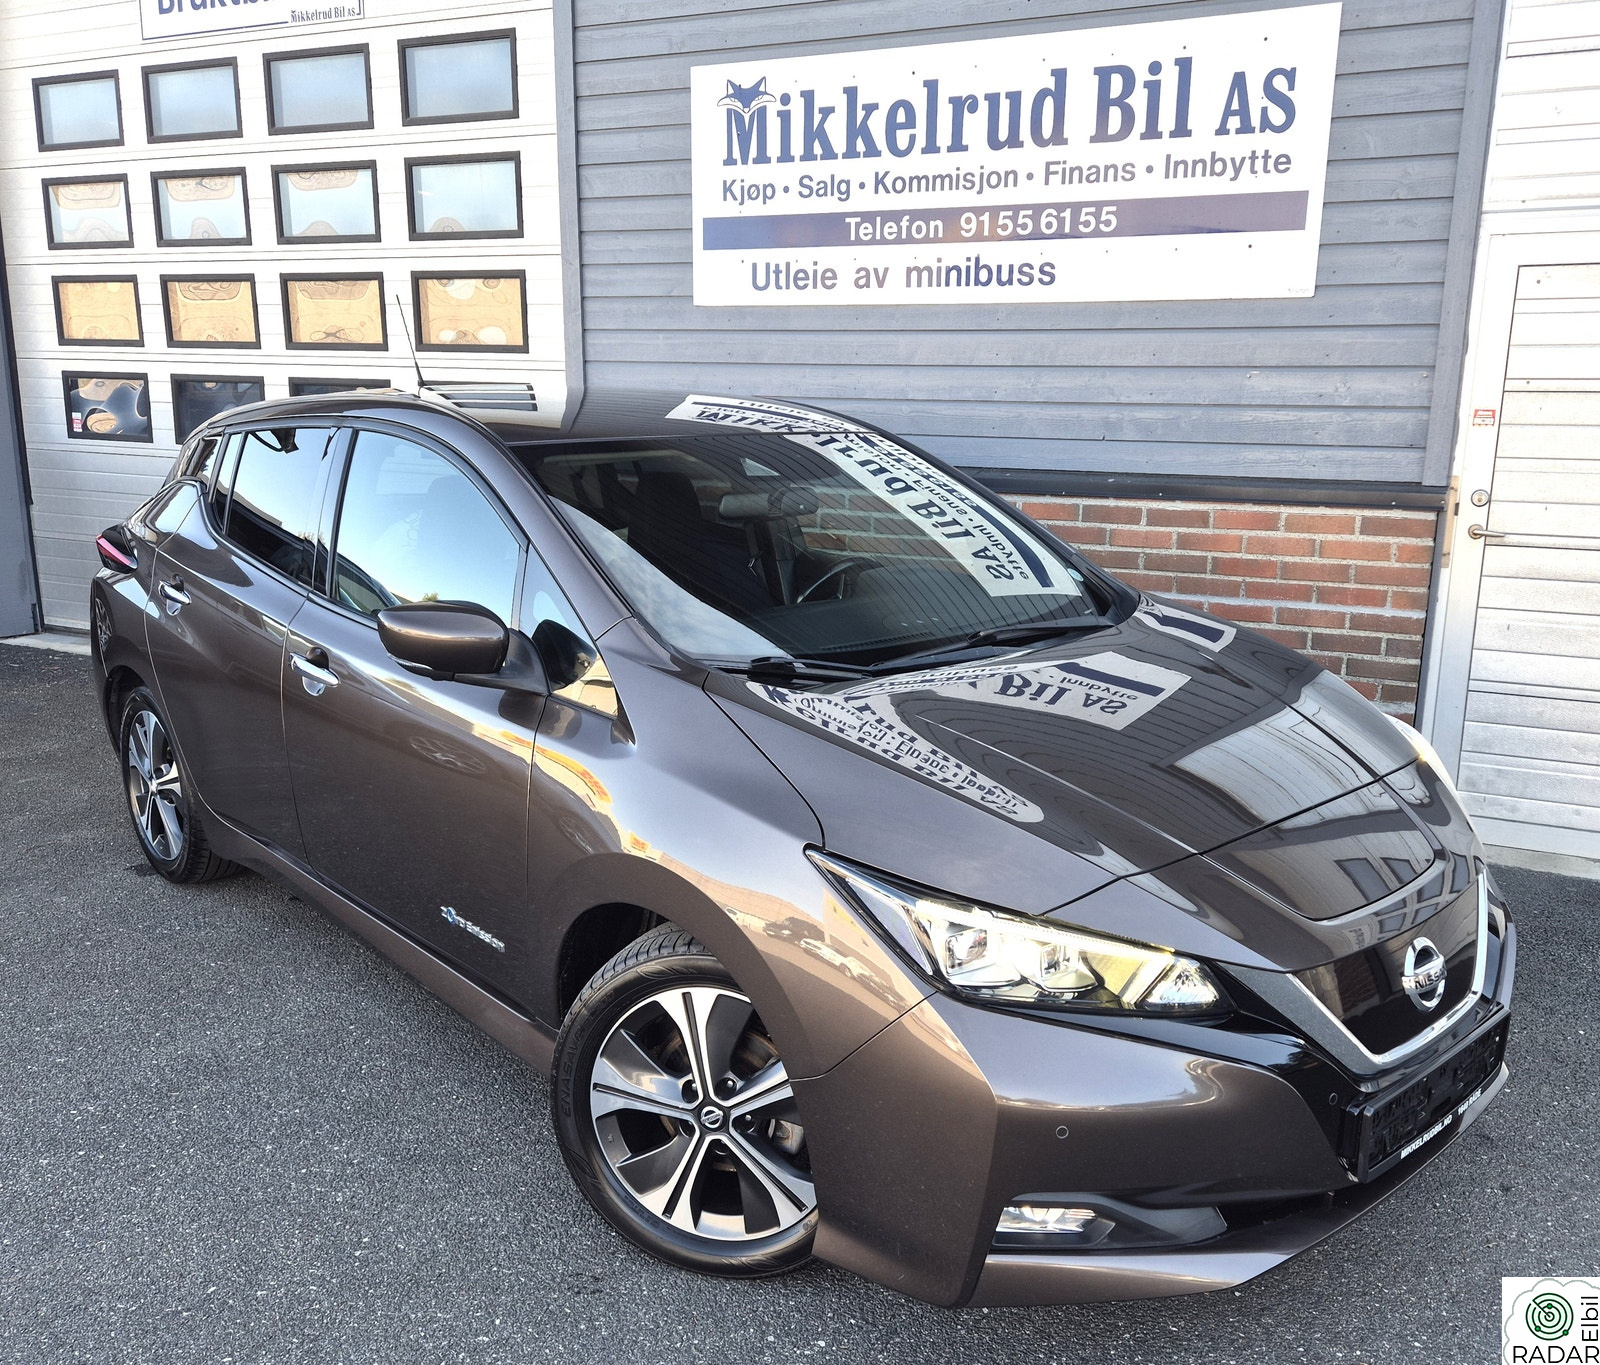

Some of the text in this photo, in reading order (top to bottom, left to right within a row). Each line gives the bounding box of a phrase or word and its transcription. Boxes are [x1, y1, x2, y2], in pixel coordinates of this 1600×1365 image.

[291, 6, 356, 24] Mikkelrud Bil AS
[723, 56, 1297, 166] Mikkelrud Bil AS
[722, 149, 1292, 206] Kjøp Salg Kommisjon Finans Innbytte
[845, 215, 943, 241] Telefon
[751, 255, 1056, 291] Utleie av minibuss
